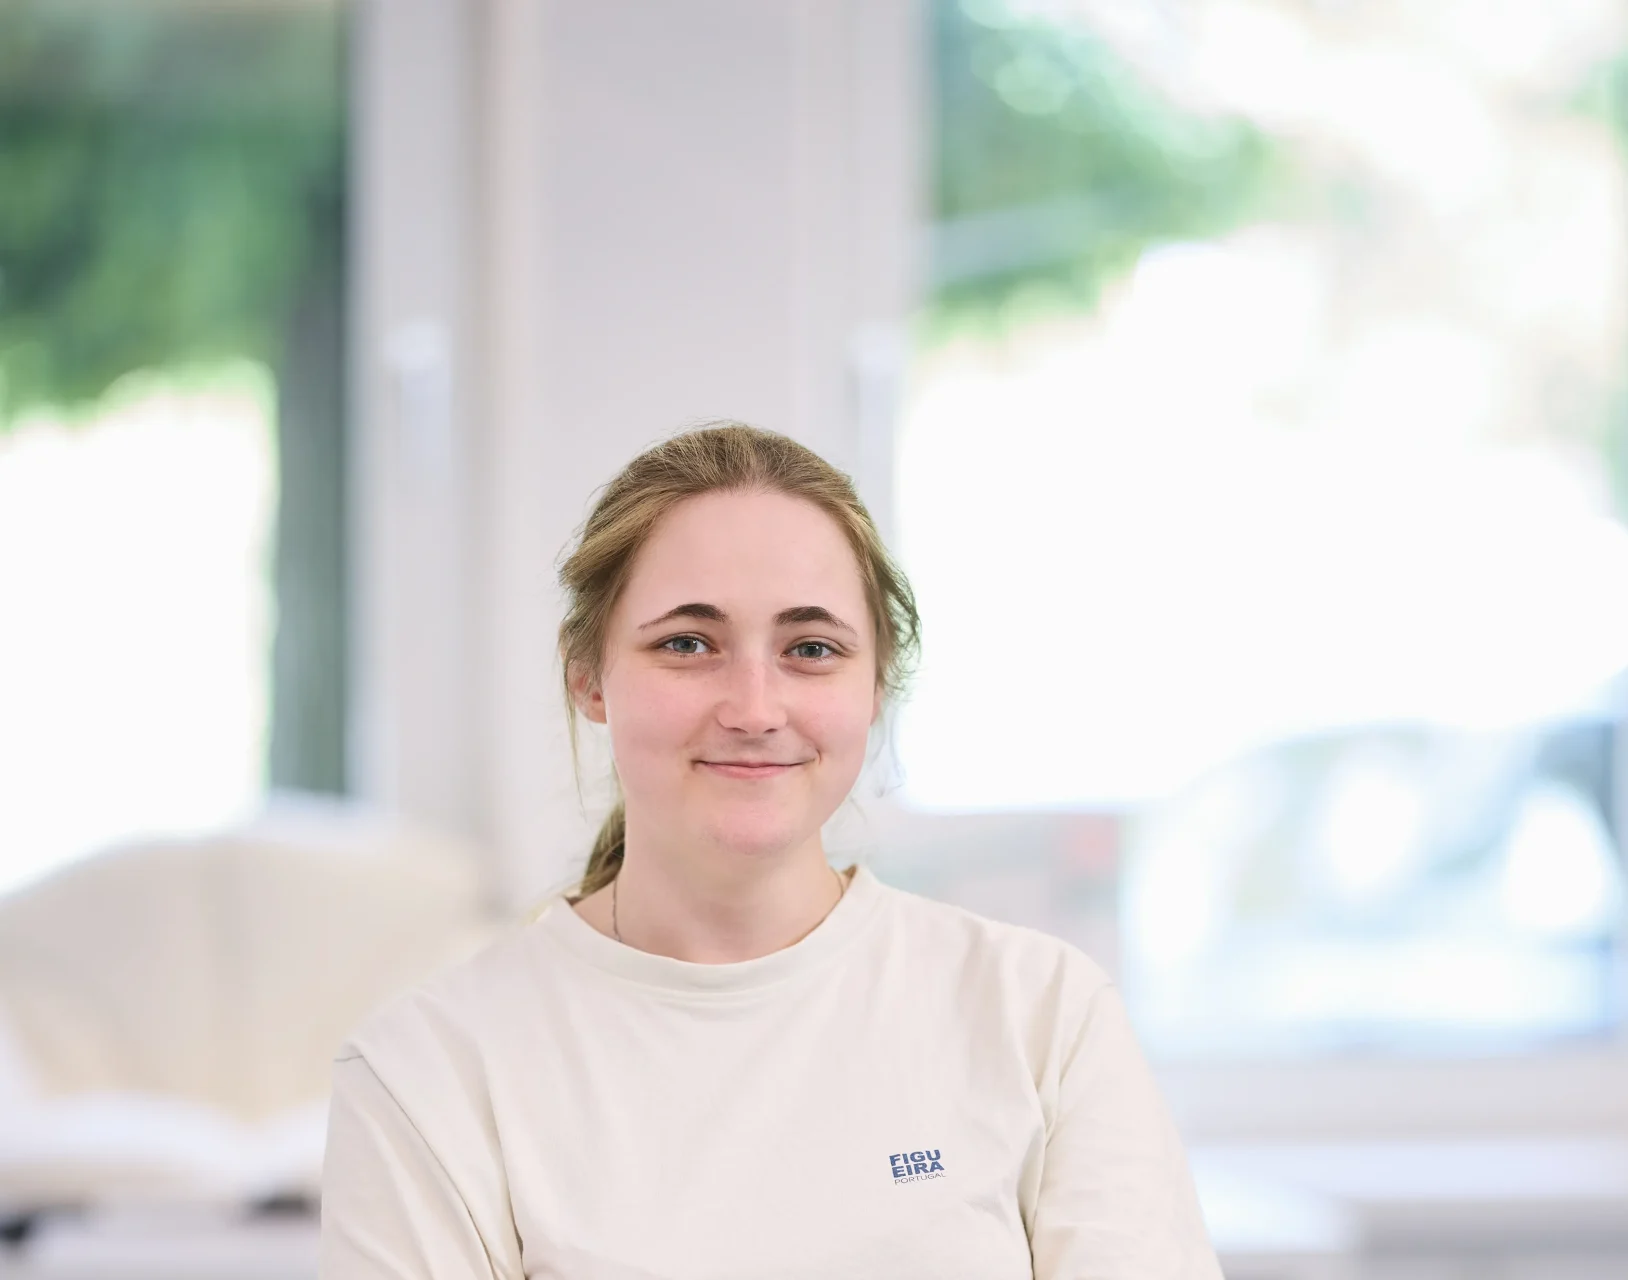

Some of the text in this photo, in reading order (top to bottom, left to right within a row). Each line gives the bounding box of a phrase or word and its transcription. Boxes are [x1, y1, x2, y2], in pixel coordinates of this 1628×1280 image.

[889, 1149, 941, 1167] FIGU
[892, 1160, 945, 1178] EIRA
[894, 1172, 947, 1185] PORTUGAL
